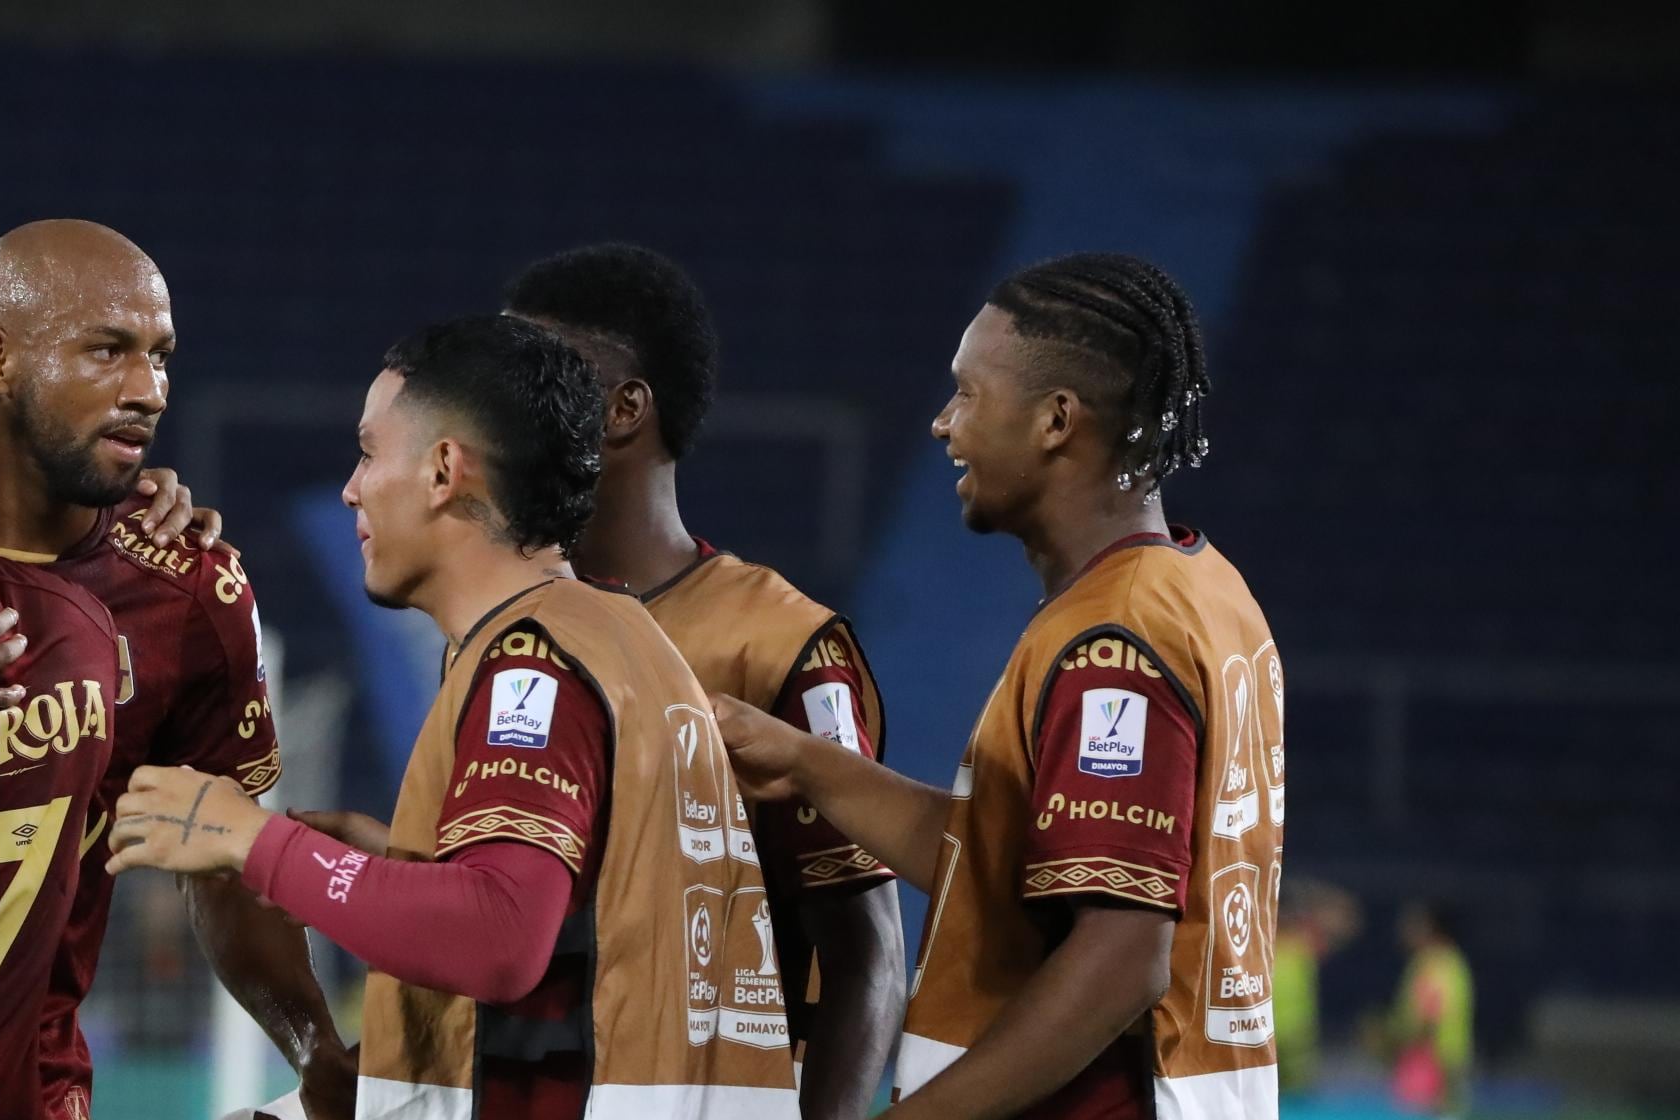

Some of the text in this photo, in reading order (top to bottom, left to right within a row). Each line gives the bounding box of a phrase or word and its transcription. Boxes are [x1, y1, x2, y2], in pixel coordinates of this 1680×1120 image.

[496, 714, 542, 730] BetPlay
[1088, 740, 1135, 756] BetPlay
[1091, 762, 1128, 772] DIMAYOR
[480, 757, 581, 801] HOLCIM
[1069, 800, 1175, 835] HOLCIM
[735, 968, 756, 977] LIGA
[735, 977, 779, 987] FEMENINA
[734, 986, 785, 1006] BetPla
[736, 1021, 789, 1036] DIMAYO
